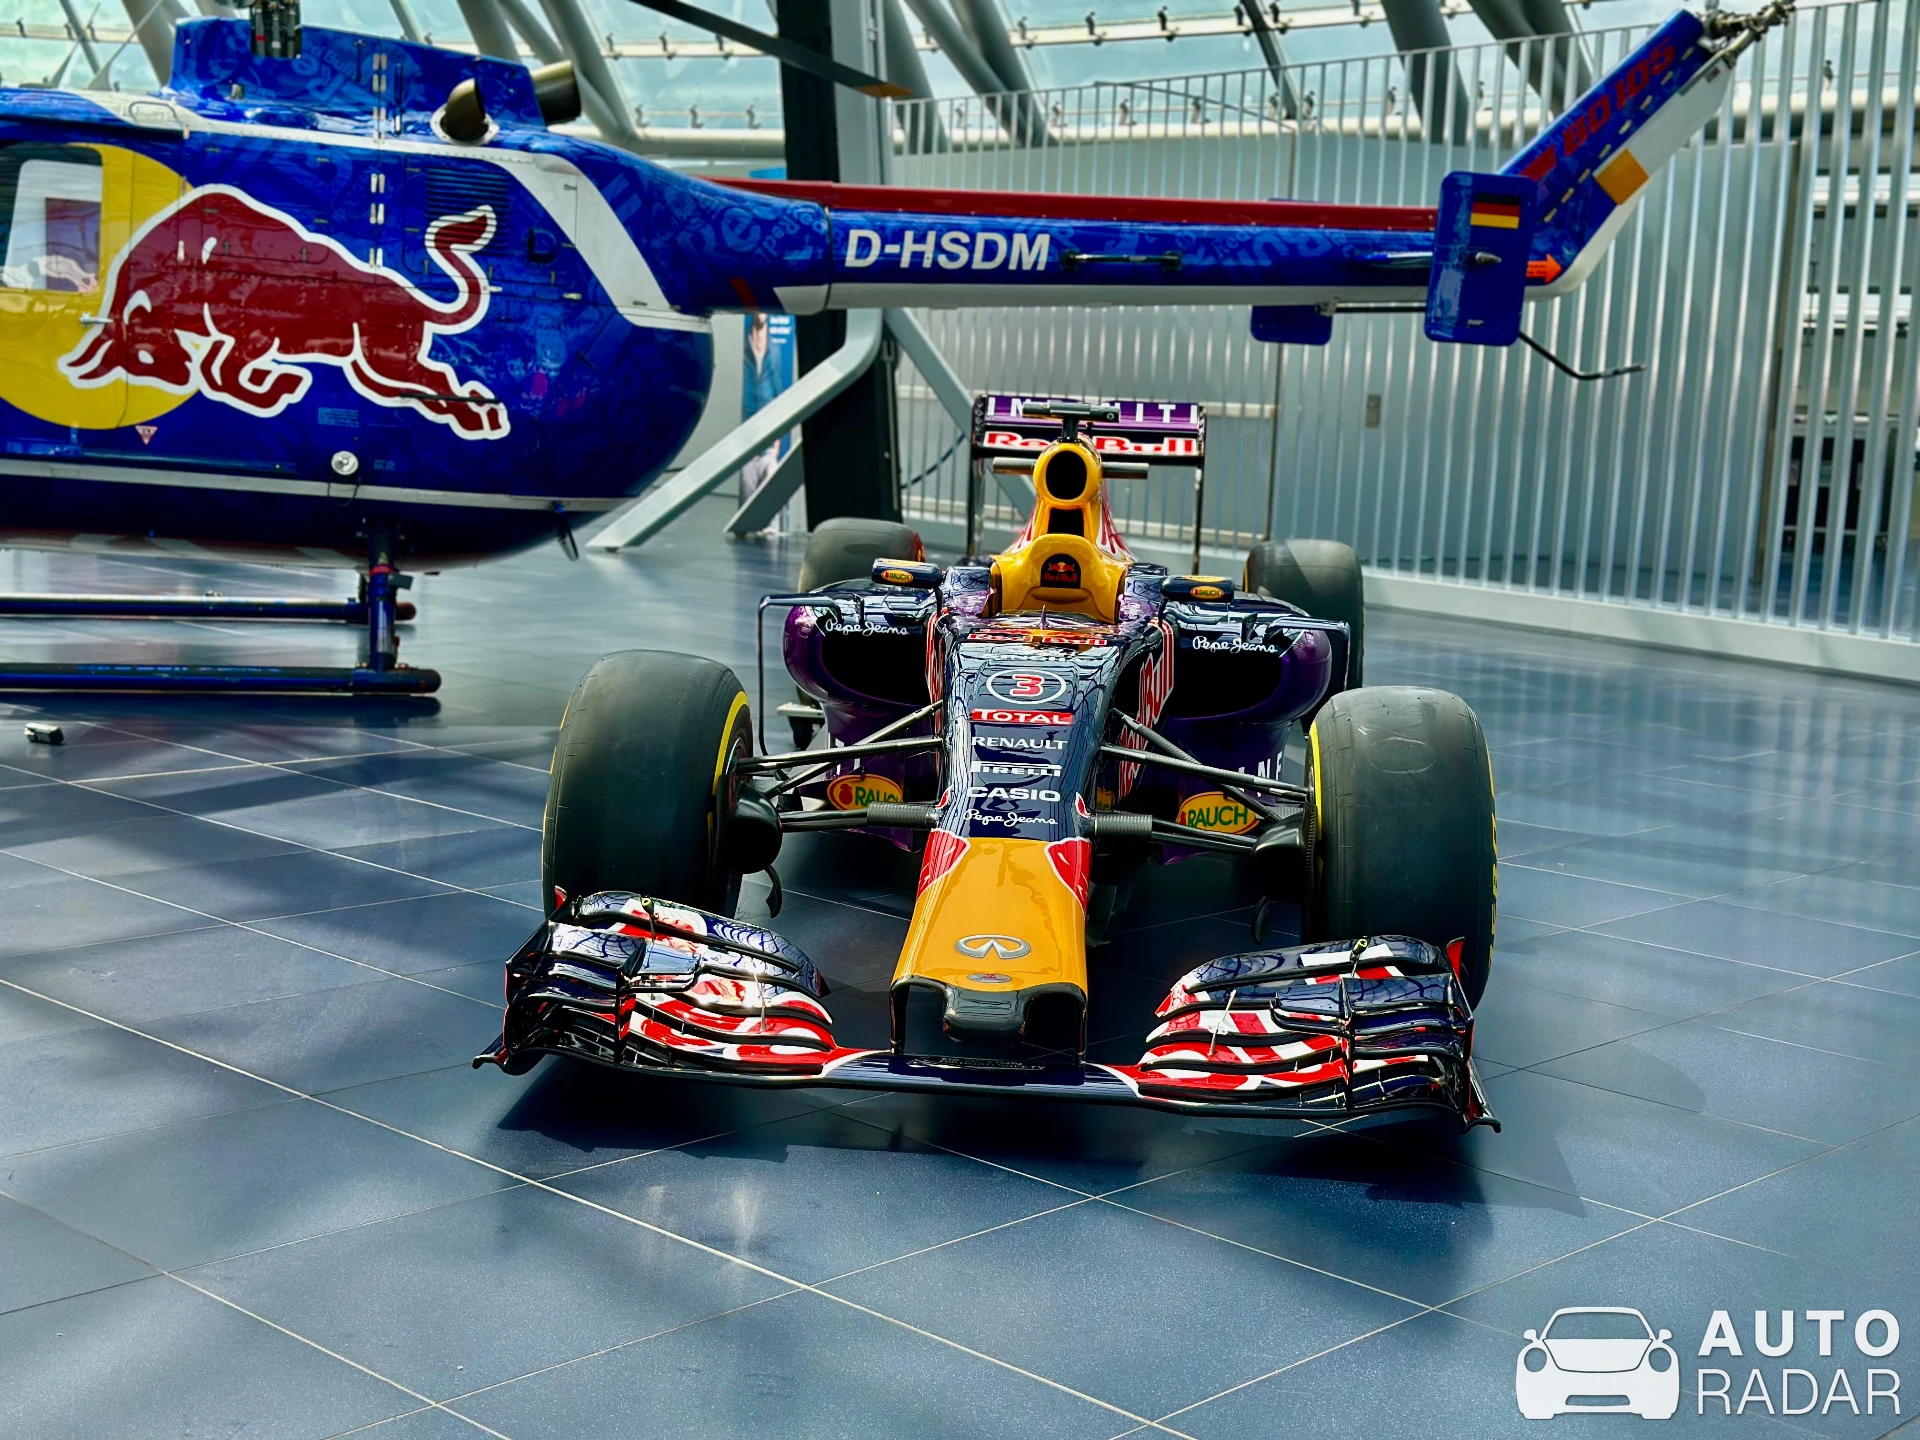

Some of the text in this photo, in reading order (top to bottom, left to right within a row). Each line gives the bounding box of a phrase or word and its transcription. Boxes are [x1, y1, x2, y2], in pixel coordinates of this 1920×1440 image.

[844, 229, 1051, 271] D-HSDM
[1093, 436, 1198, 455] Bull
[825, 618, 910, 637] Pepe Jeans
[1192, 635, 1273, 654] Pepe Jeans
[1010, 673, 1045, 698] 3
[974, 708, 1070, 725] TOTAL
[971, 736, 1068, 750] RENAULT
[970, 760, 1063, 778] PIRELLI
[967, 786, 1061, 802] CASIO
[963, 808, 1059, 827] Pepe Jeans
[1188, 806, 1249, 829] RAUCH
